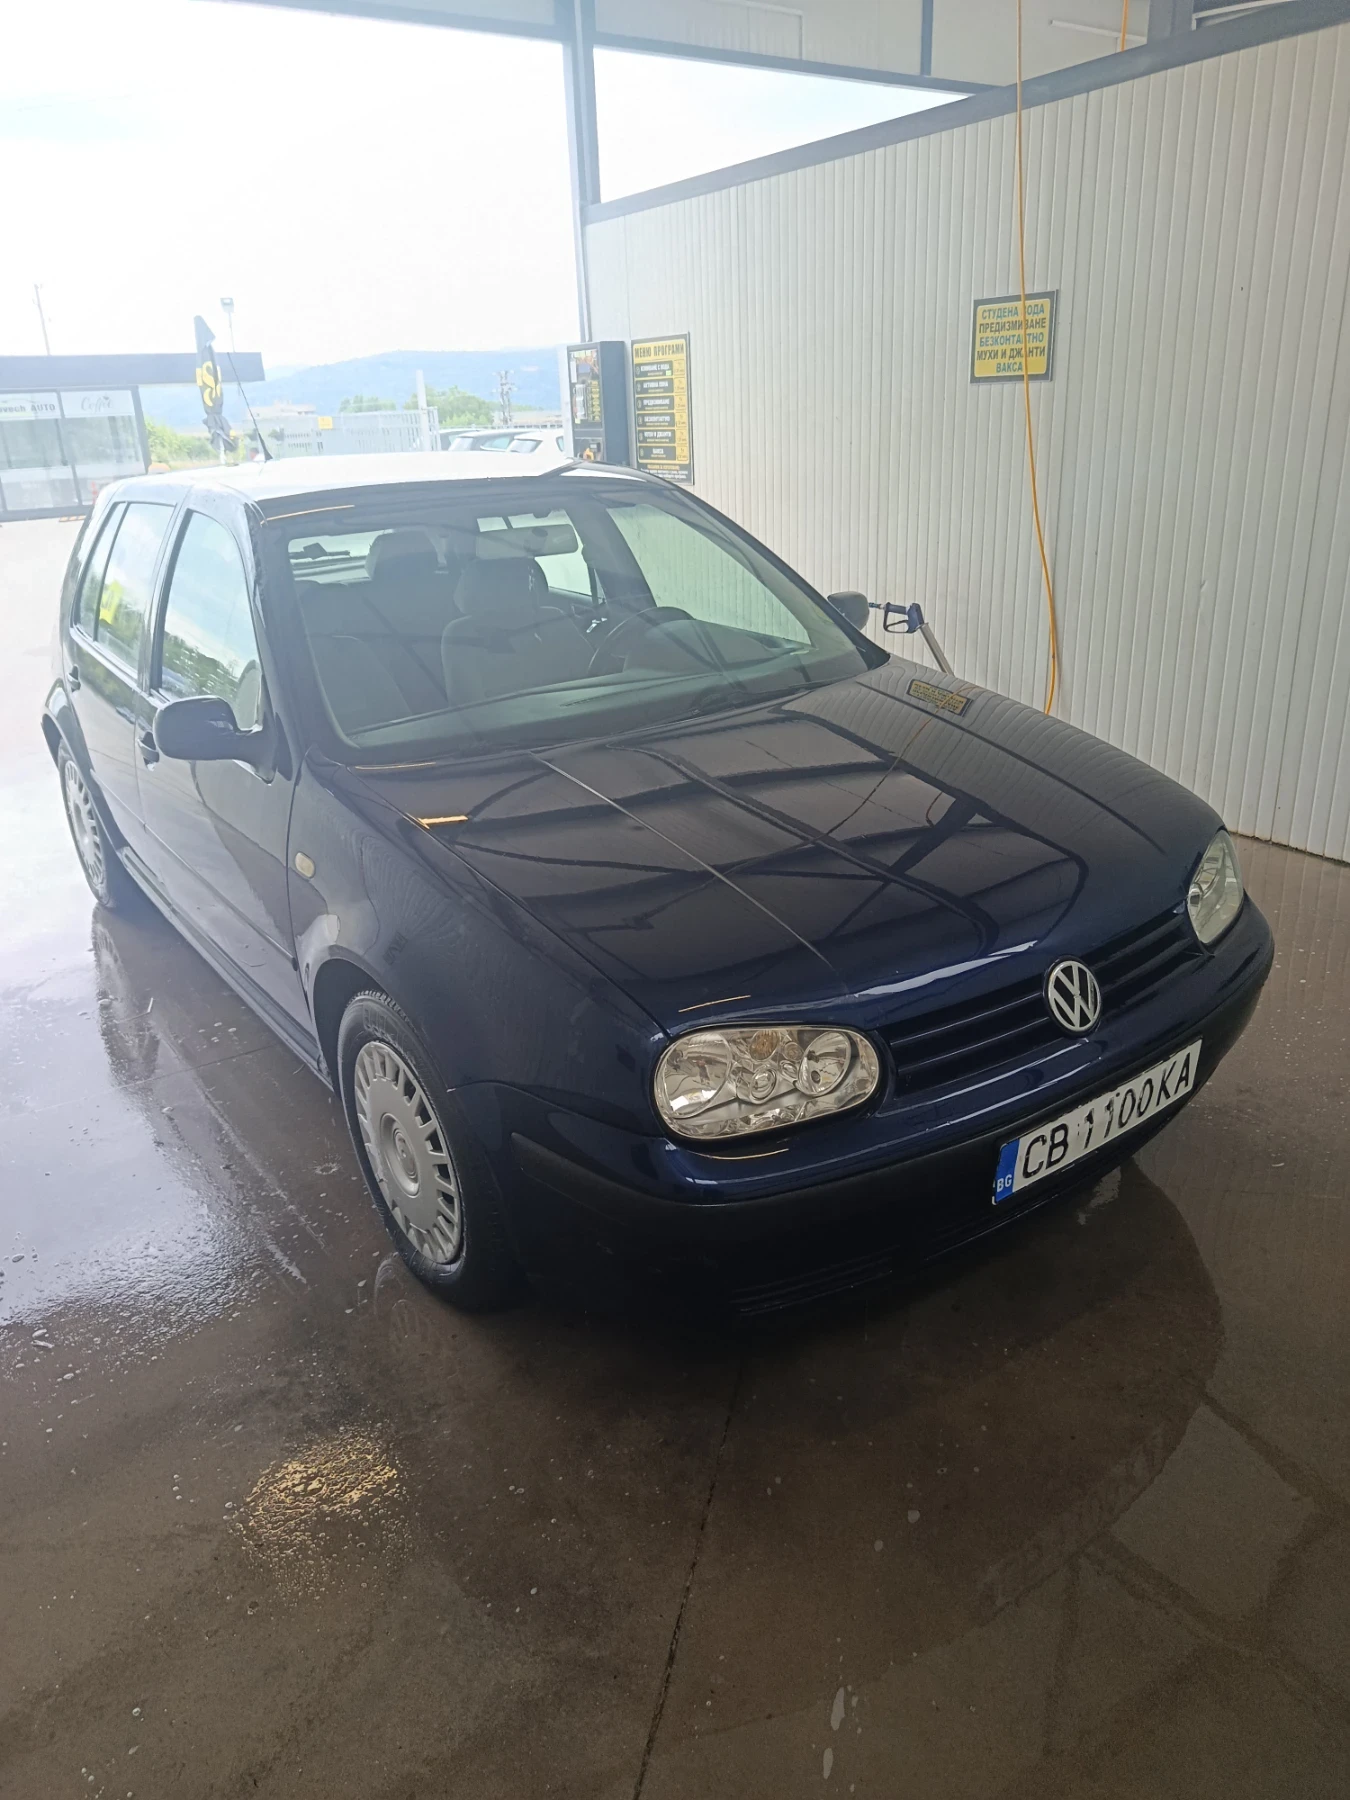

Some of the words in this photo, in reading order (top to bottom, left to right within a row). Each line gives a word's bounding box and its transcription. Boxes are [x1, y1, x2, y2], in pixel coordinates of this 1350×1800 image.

[981, 306, 1019, 320] СТУДЕНА
[634, 347, 652, 358] МЕНЮ
[653, 343, 685, 357] ПРОГРАМИ
[976, 349, 999, 361] МУХИ
[1001, 348, 1007, 359] И
[1008, 346, 1046, 360] ДЖНТИ
[996, 362, 1023, 373] ВАКСА
[31, 403, 56, 412] AUTO
[996, 1174, 1013, 1192] BG
